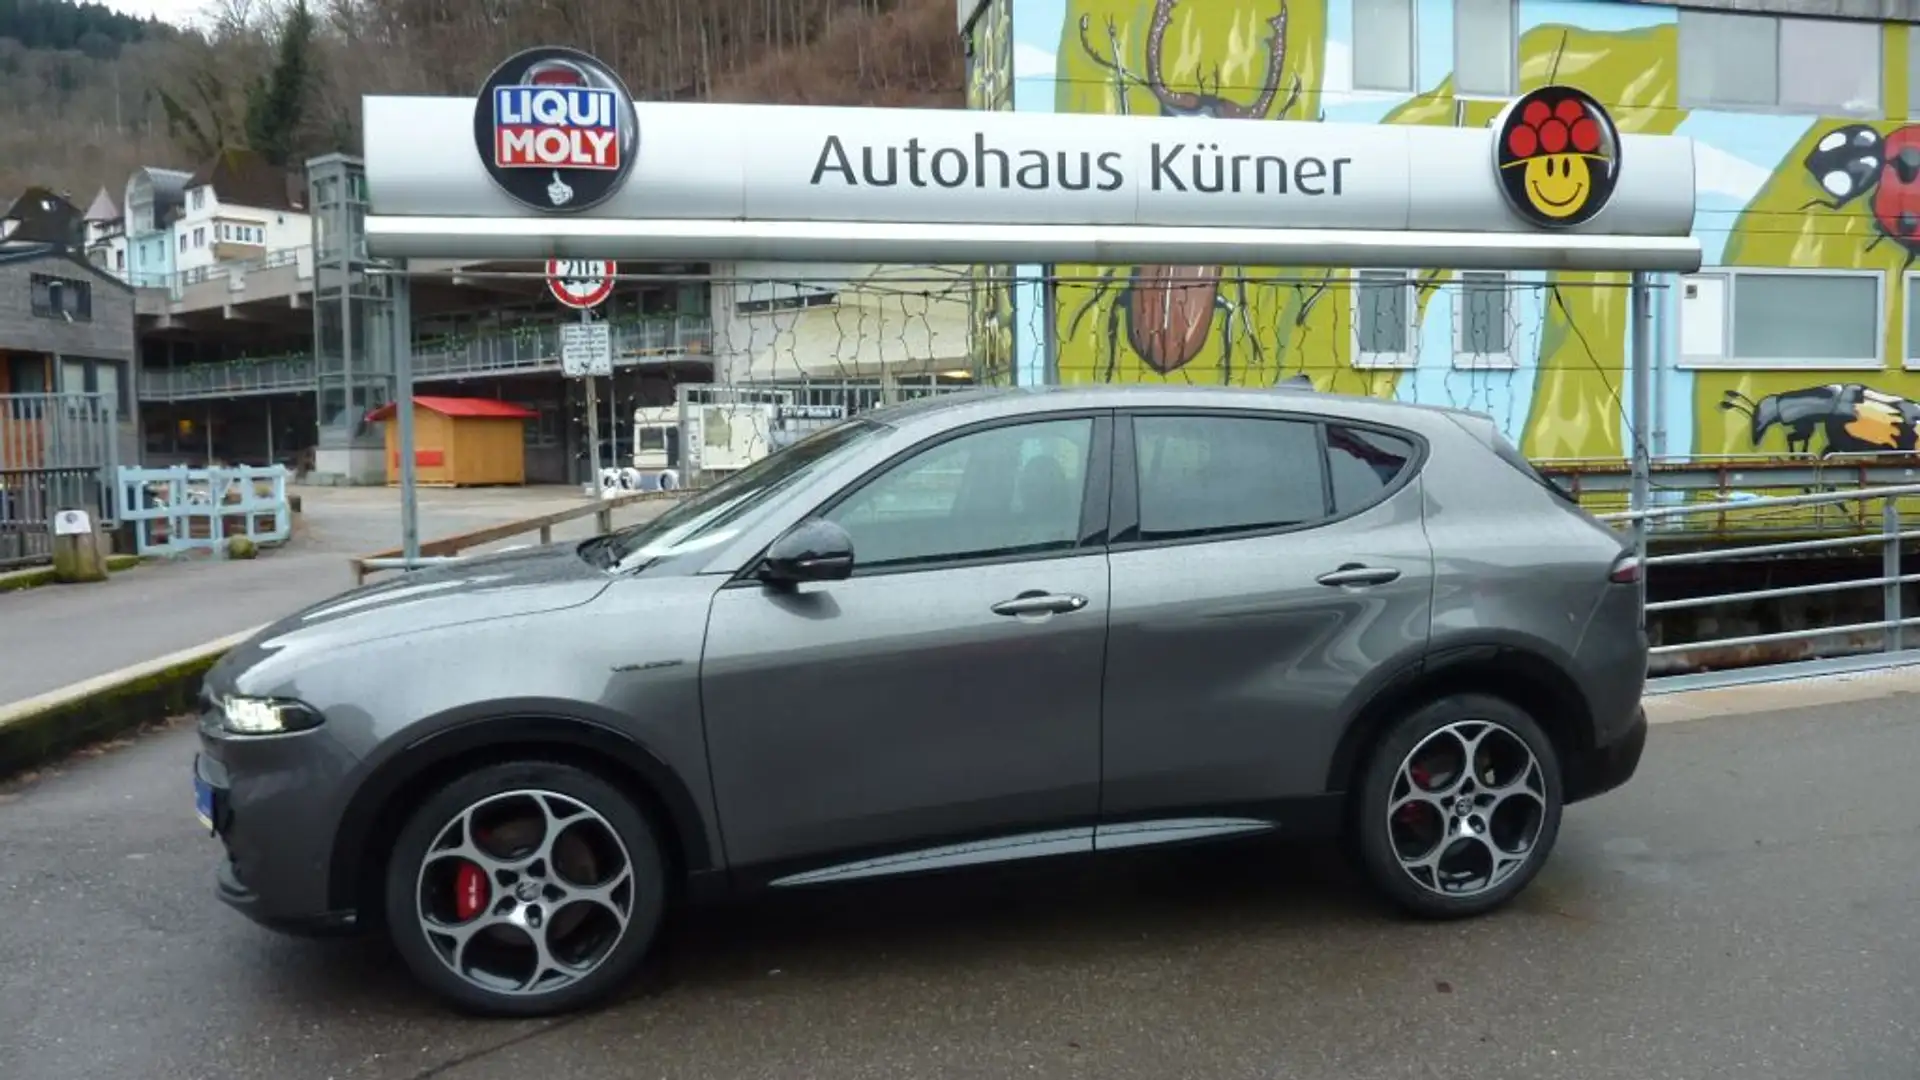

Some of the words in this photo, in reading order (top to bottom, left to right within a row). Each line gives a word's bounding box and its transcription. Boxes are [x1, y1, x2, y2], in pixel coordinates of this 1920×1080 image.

[501, 90, 611, 127] LIQUI
[502, 128, 615, 164] MOLY
[809, 132, 1123, 191] Autohaus
[1151, 143, 1352, 195] Kürner
